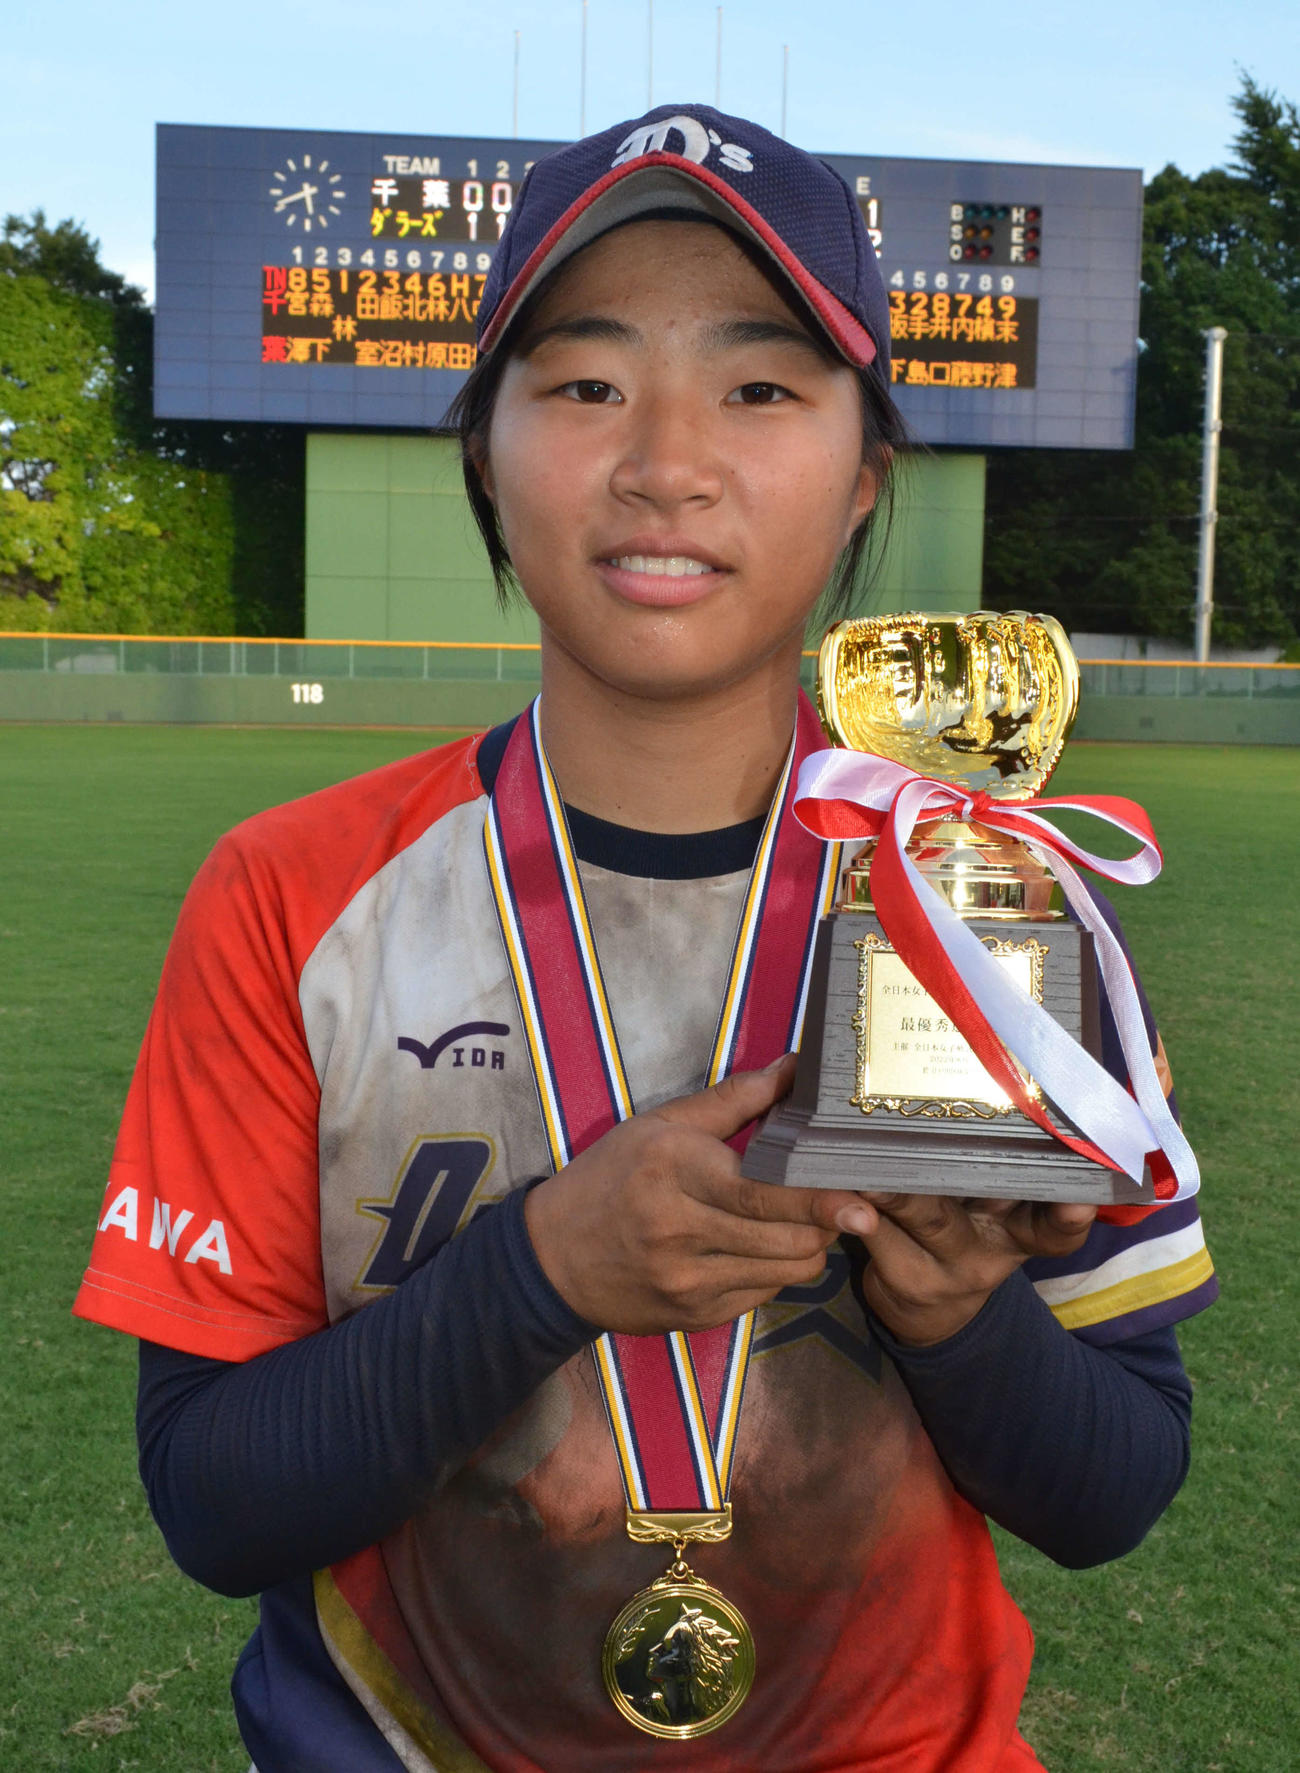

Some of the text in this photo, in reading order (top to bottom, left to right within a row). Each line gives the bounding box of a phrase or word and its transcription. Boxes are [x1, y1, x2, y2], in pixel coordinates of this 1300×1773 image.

[383, 155, 440, 175] TEAM
[467, 159, 477, 178] 1
[496, 160, 509, 179] 2
[856, 176, 871, 195] E
[370, 208, 444, 237] ダラーズ
[291, 683, 324, 704] 118
[97, 1181, 233, 1276] AWA
